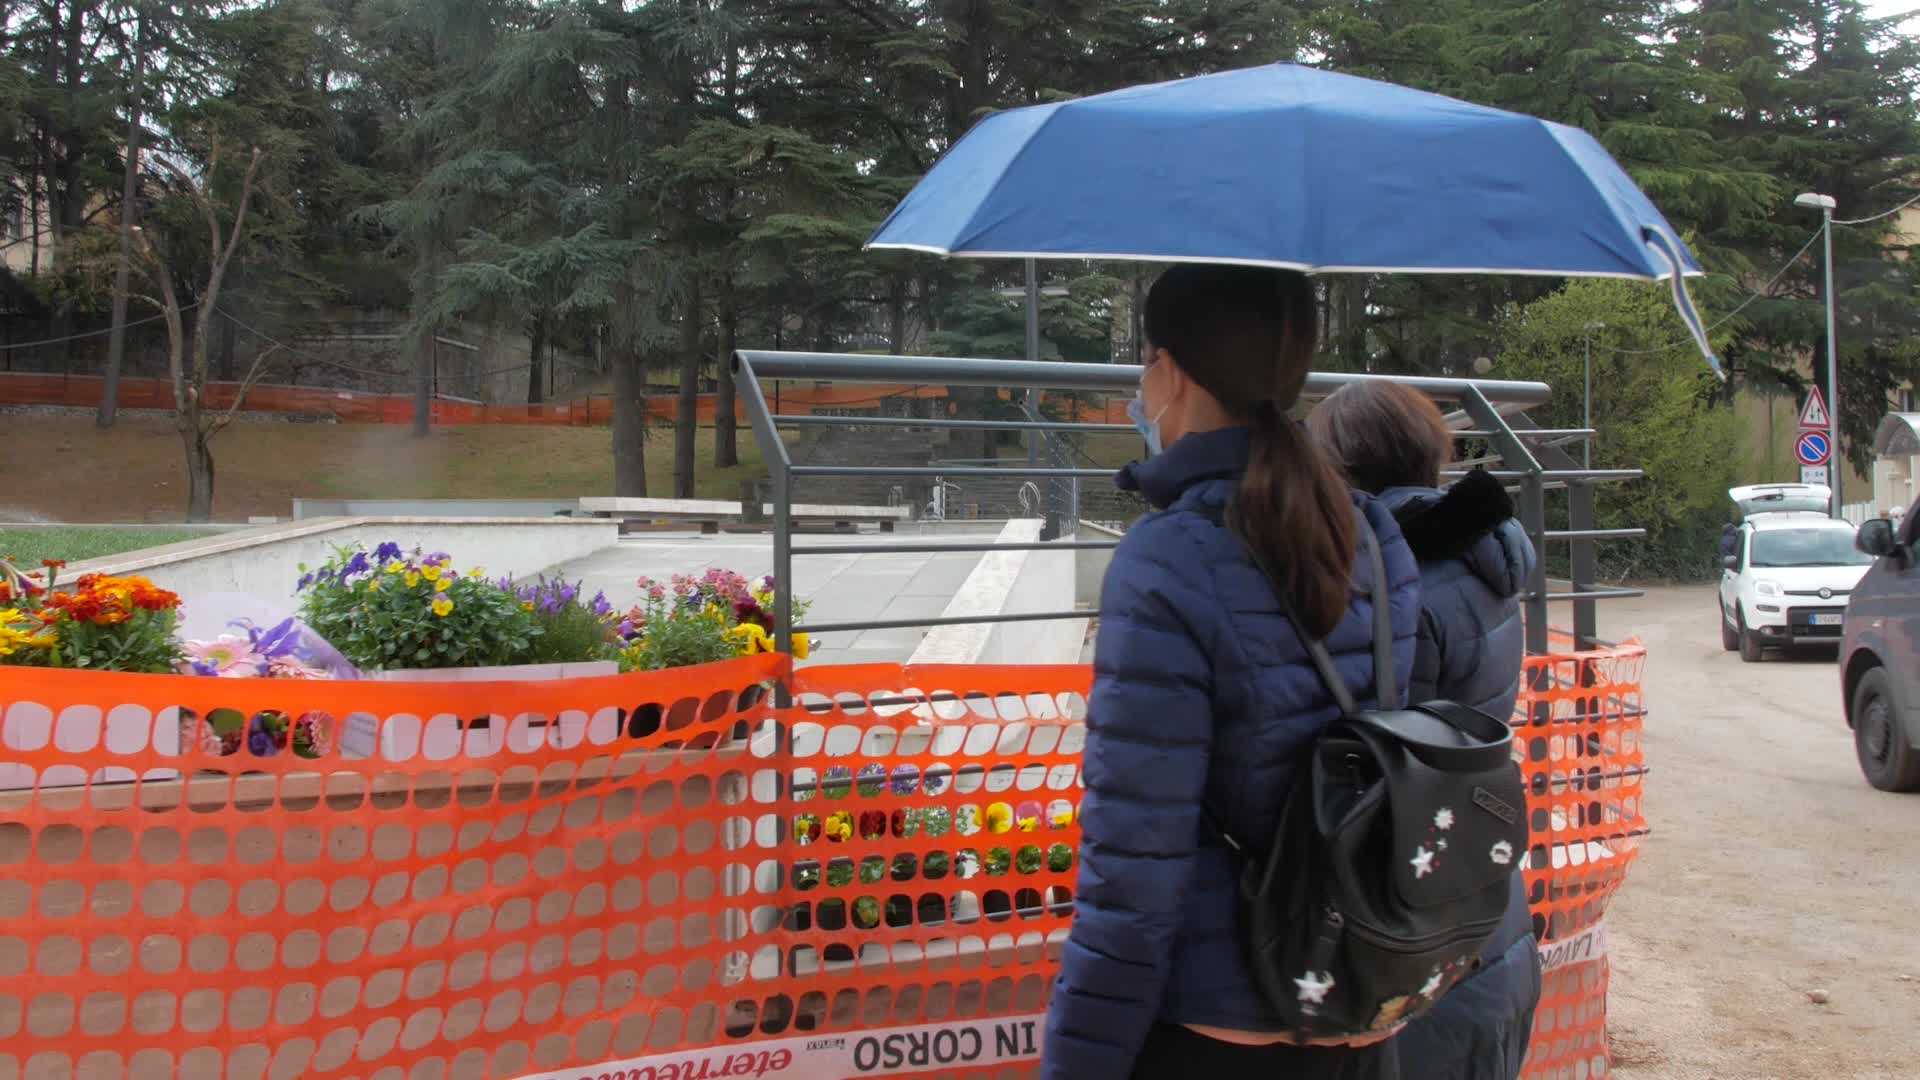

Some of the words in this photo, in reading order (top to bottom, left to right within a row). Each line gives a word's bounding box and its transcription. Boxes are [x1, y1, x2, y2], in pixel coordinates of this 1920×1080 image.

[1537, 932, 1592, 969] LAVOR
[854, 1027, 982, 1071] CORSO
[995, 1021, 1037, 1057] IN
[577, 1048, 793, 1080] eterne
